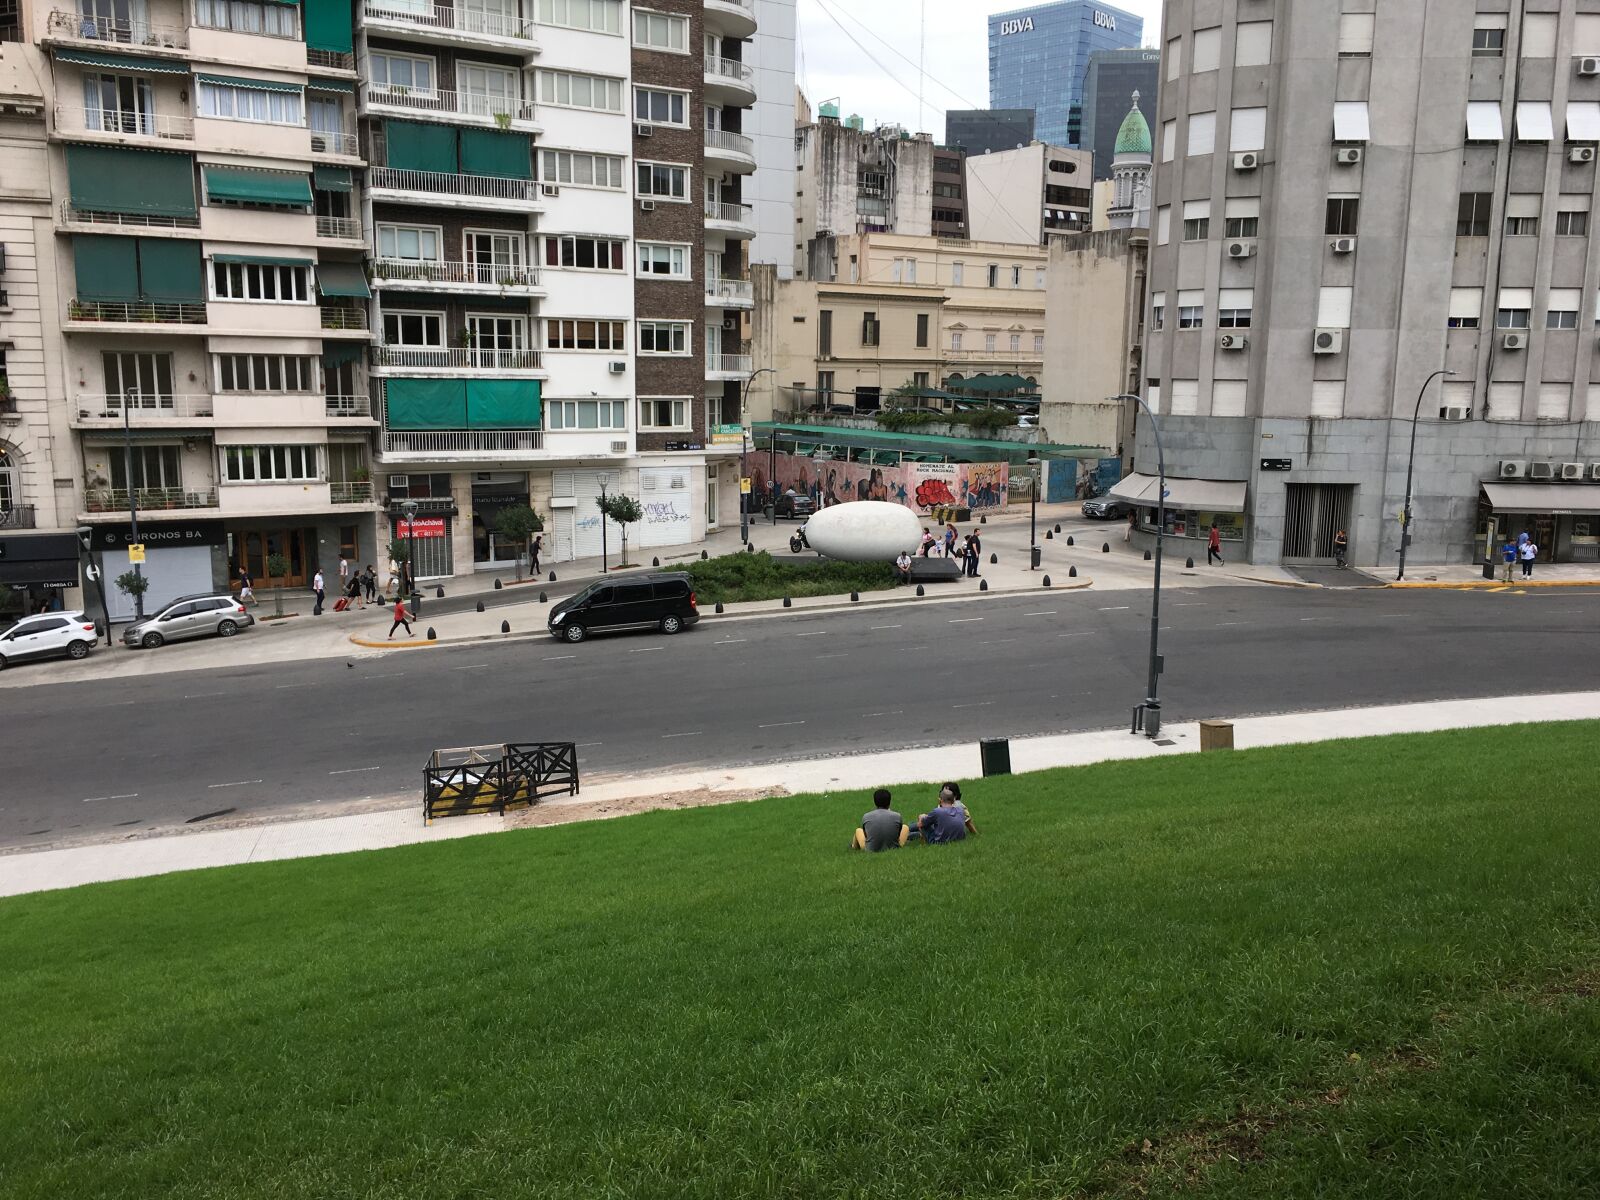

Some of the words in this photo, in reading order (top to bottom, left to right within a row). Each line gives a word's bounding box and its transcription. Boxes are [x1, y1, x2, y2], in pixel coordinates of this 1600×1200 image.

[1001, 17, 1034, 36] BBVA
[1092, 10, 1116, 31] BBVA
[185, 530, 202, 539] BA
